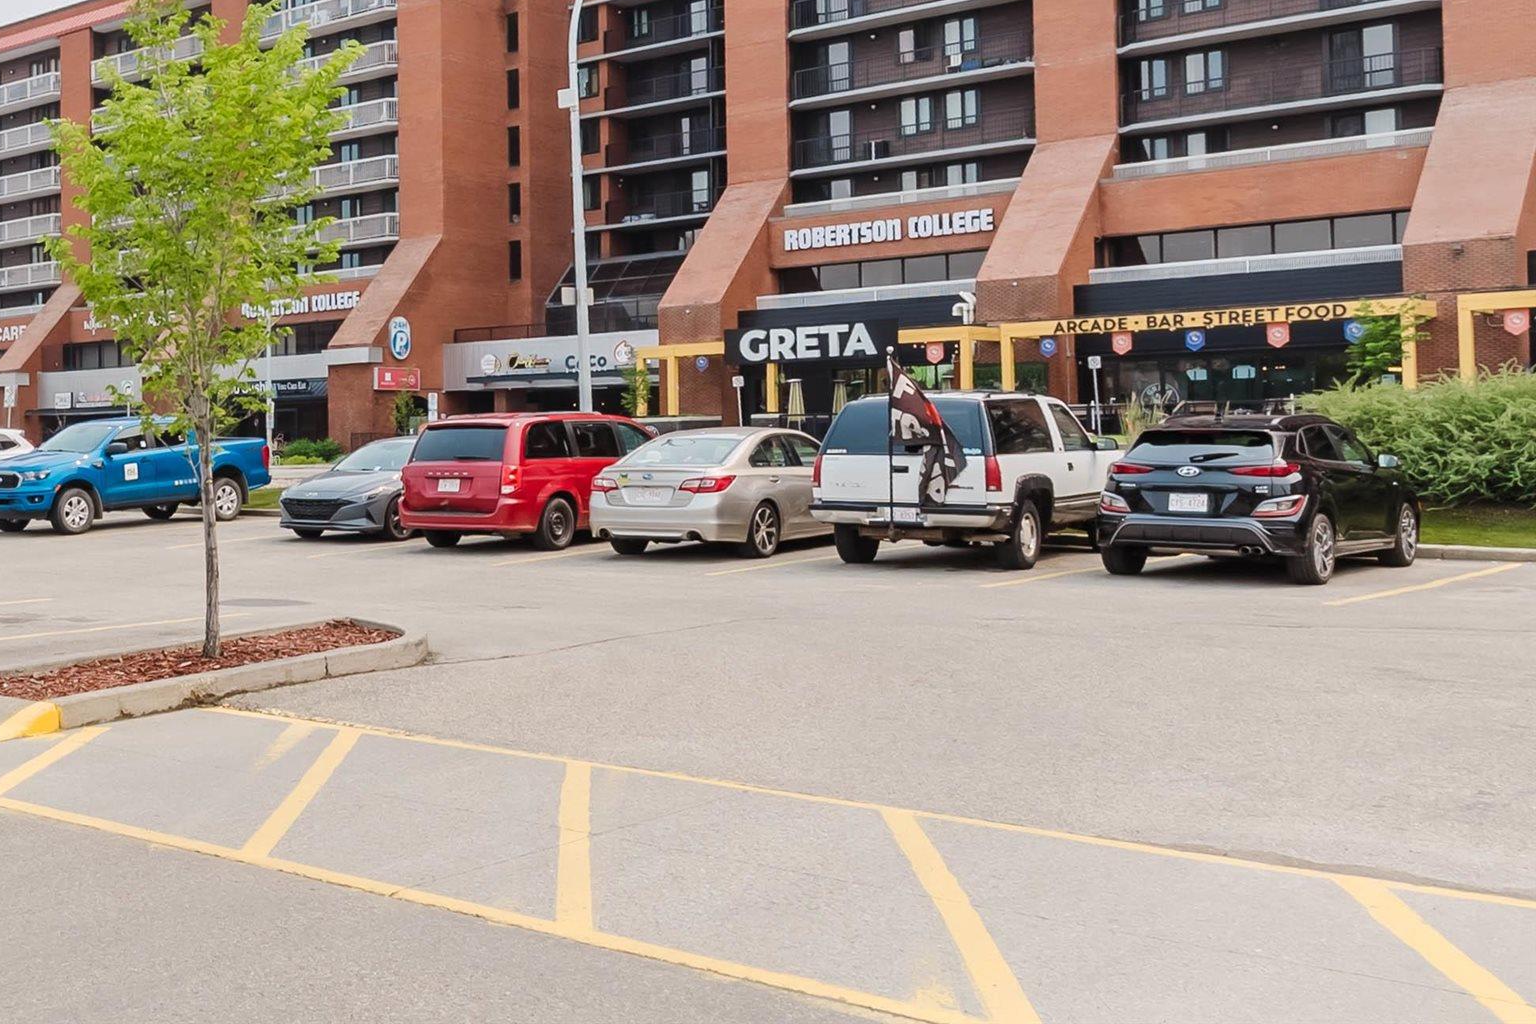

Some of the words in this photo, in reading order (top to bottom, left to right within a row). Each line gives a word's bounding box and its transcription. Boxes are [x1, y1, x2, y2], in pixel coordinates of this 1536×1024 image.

[784, 218, 902, 251] ROBERTSON
[907, 208, 994, 239] COLLEGE
[1053, 317, 1128, 335] ARCADE
[1146, 314, 1184, 328] BAR
[1203, 307, 1279, 325] STREET
[1284, 304, 1347, 321] FOOD
[739, 322, 878, 363] GRETA
